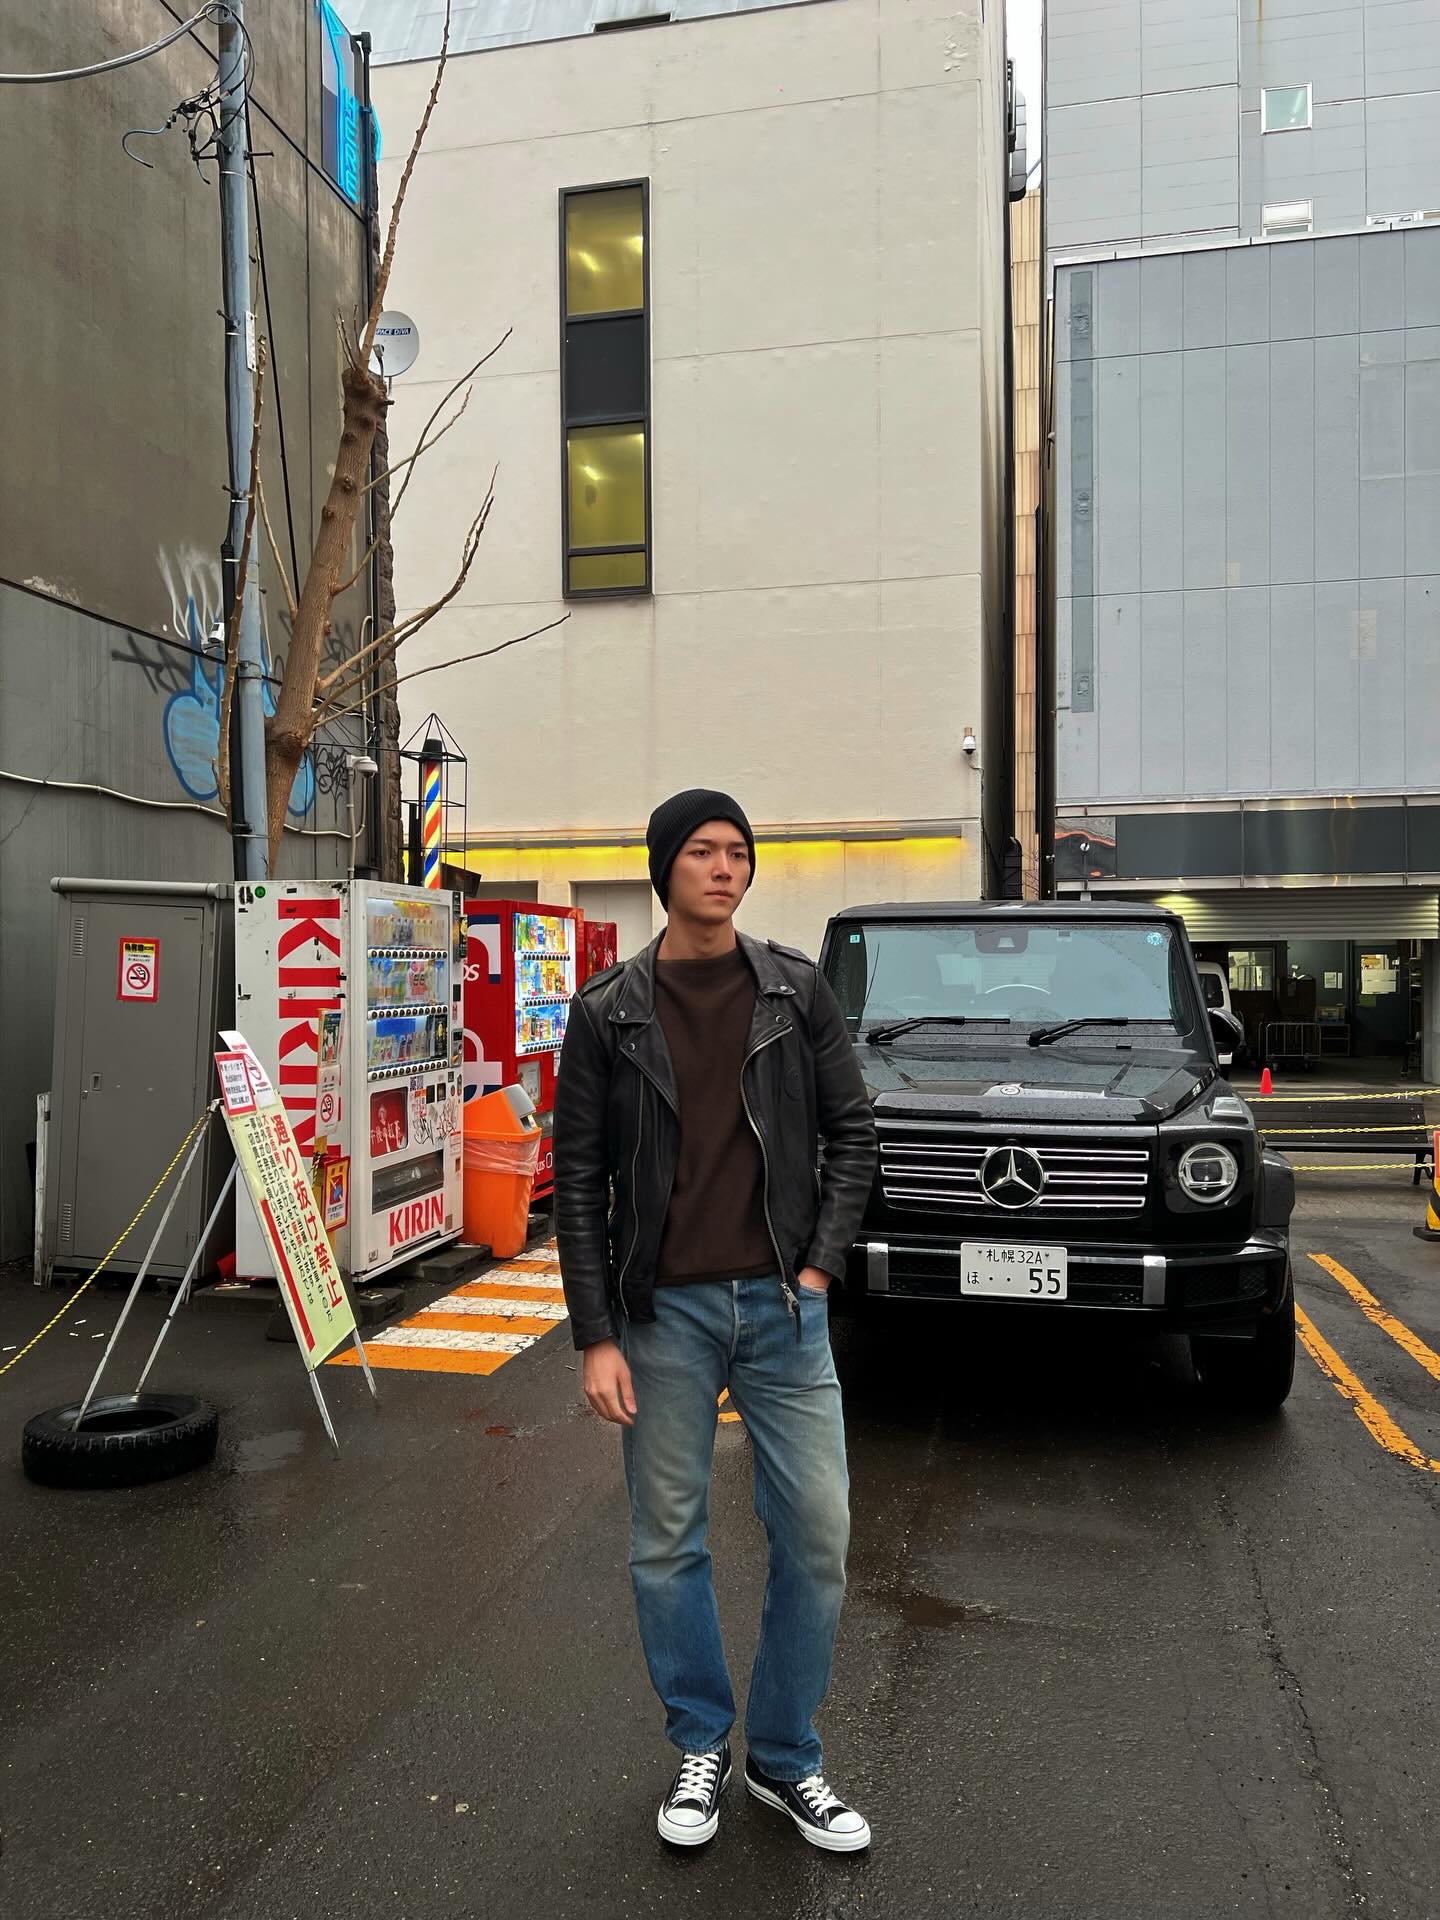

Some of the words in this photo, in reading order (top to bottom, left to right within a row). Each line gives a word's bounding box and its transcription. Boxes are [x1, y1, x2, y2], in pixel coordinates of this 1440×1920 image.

[278, 899, 341, 1159] KIRIN
[269, 1113, 343, 1309] 通り抜け禁止
[389, 1193, 443, 1247] KIRIN
